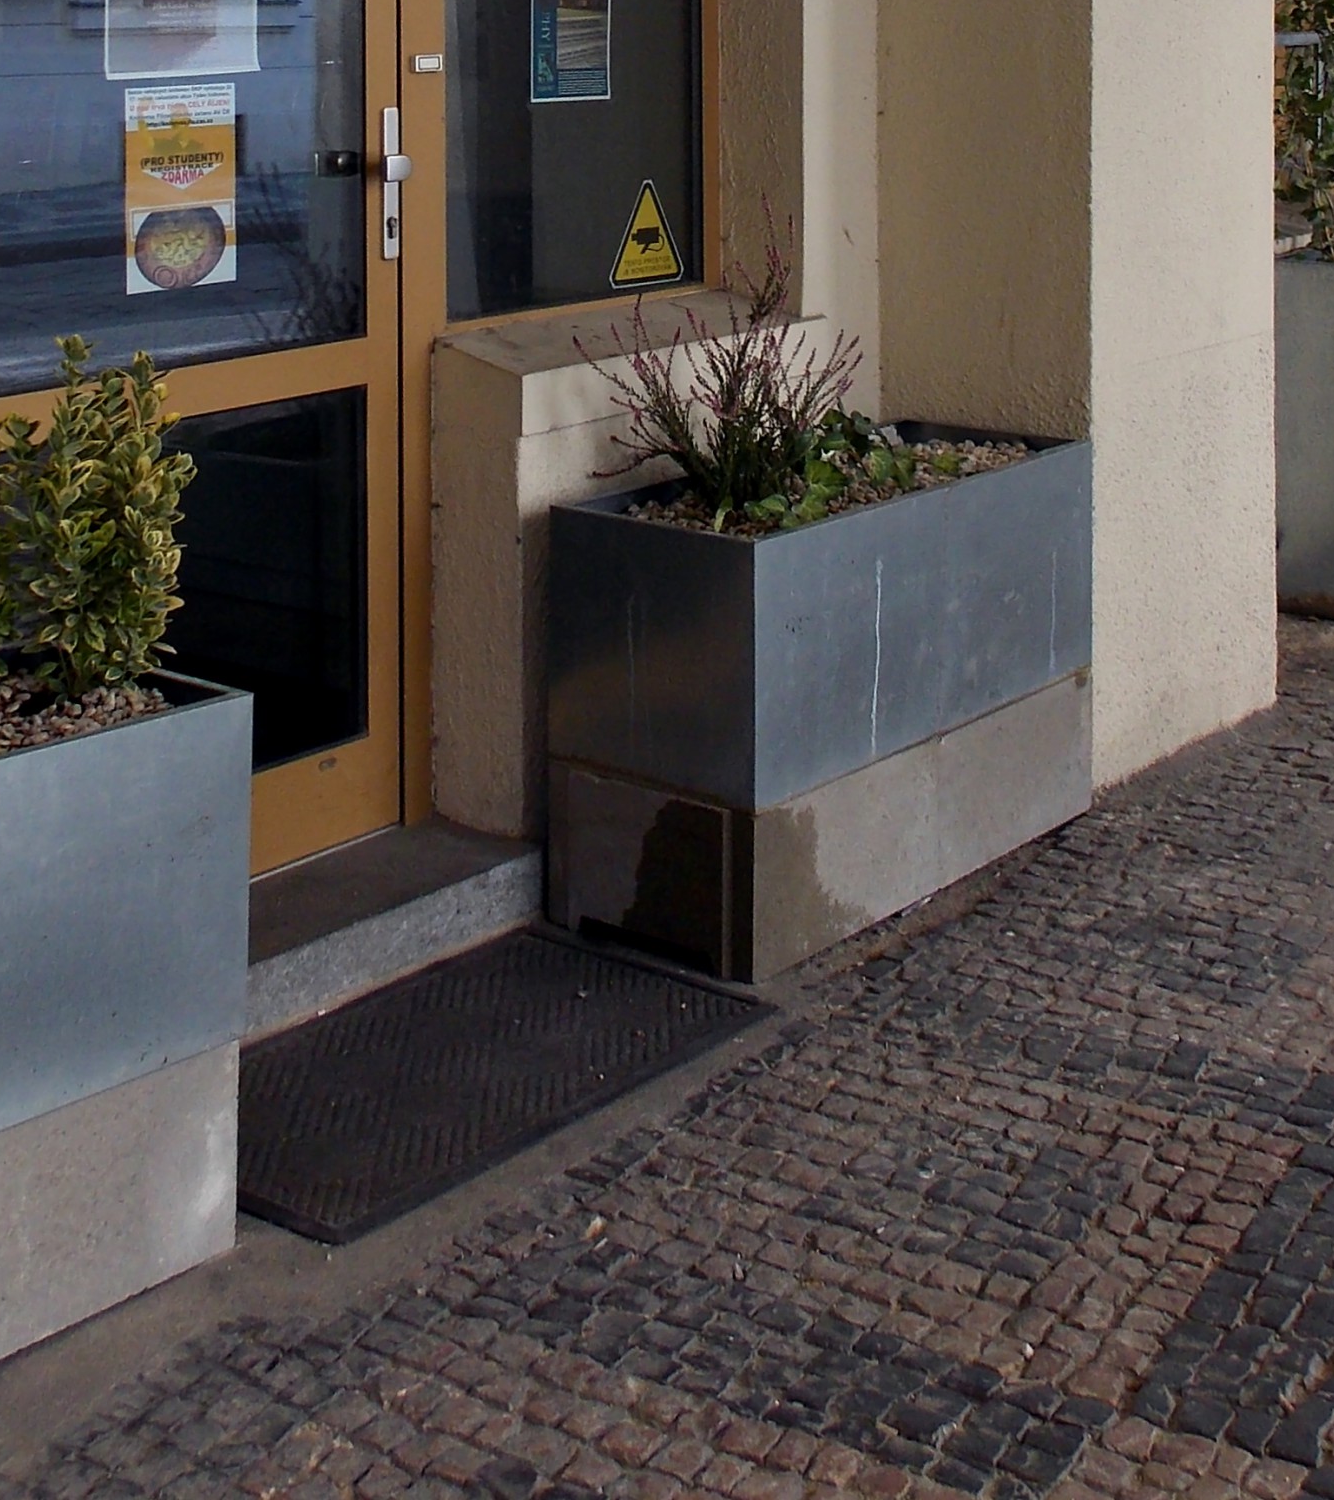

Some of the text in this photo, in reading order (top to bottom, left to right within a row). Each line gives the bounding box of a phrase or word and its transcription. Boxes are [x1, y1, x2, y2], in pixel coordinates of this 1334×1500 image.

[140, 151, 224, 169] (PRO STUDENTY)
[161, 169, 204, 184] ZDARMA
